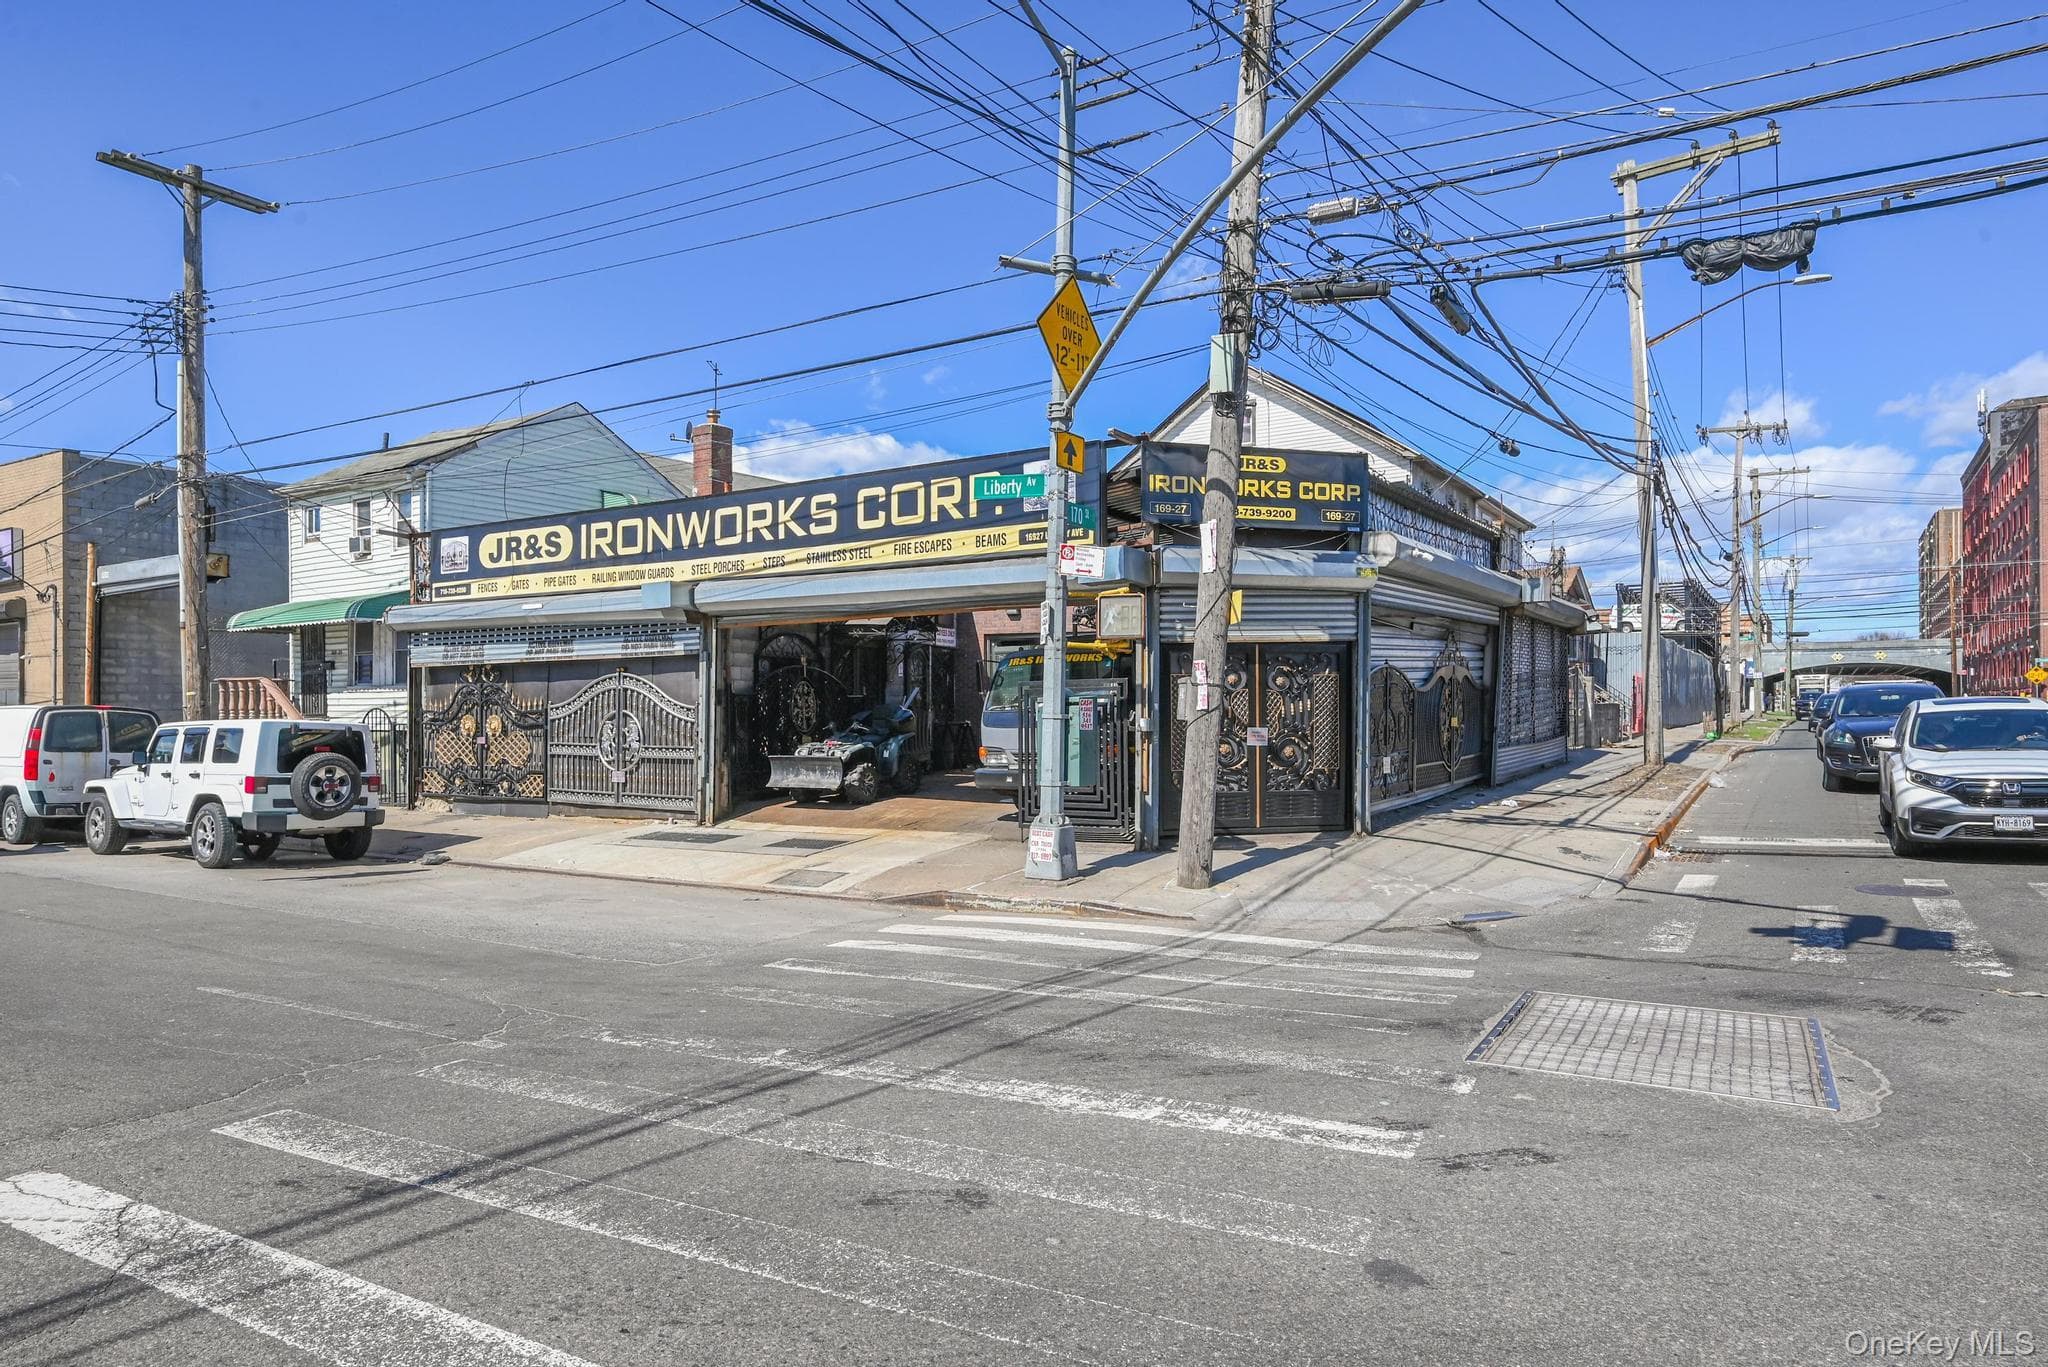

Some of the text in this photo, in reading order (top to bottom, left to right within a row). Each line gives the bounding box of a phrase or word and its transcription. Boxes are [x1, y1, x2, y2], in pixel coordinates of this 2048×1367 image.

[1056, 302, 1089, 331] VEHICLES
[1062, 326, 1082, 348] OVER
[984, 476, 1036, 497] Liberty Av
[1149, 474, 1360, 502] IRONRKS CORP.
[1070, 506, 1083, 524] 170
[1154, 504, 1187, 514] 169-27
[1236, 508, 1292, 518] -739-9200
[1326, 512, 1356, 521] 169-27
[488, 531, 562, 563] JR&S
[581, 493, 838, 560] IRONWORKS
[1072, 528, 1084, 537] AVE
[478, 533, 1007, 593] FENCES GATES PIPE GATES RAILING WINDOW GUARDS STEEL PORCHES STEPS STAINLESS STEEL FIRE ESCAPES BEAMS
[1008, 653, 1103, 667] JR&S IWORKS
